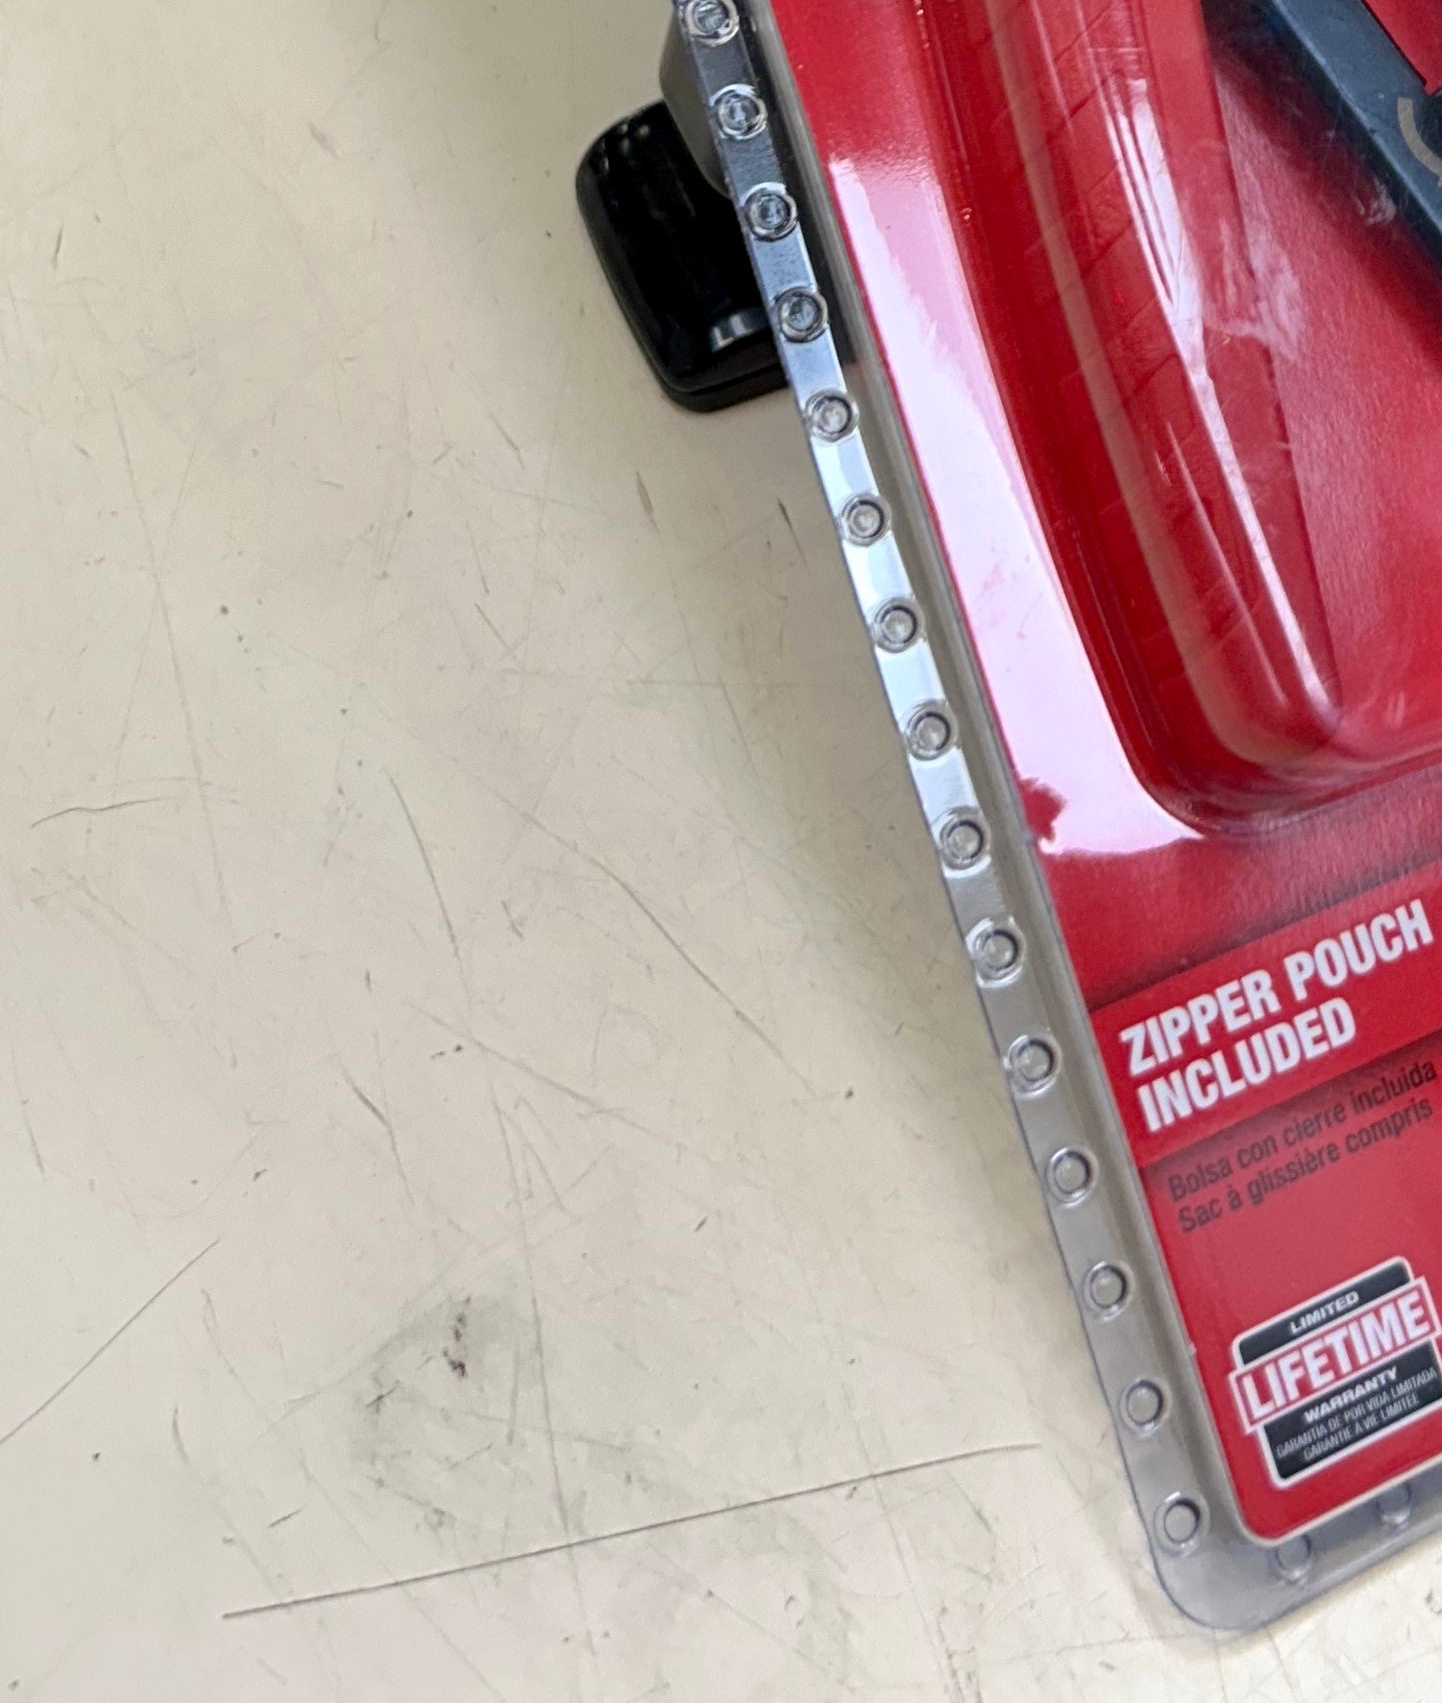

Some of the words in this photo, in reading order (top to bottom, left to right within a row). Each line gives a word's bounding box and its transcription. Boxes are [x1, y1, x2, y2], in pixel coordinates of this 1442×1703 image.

[1118, 968, 1282, 1077] ZIPPER
[1284, 899, 1435, 1001] POUCH
[1136, 997, 1357, 1133] INCLUDED
[1167, 1155, 1234, 1203] Bolsa
[1237, 1136, 1279, 1171] con
[1281, 1104, 1347, 1148] cierre
[1351, 1058, 1438, 1117] incluida
[1177, 1196, 1224, 1235] Sac
[1246, 1139, 1341, 1205] glissière
[1345, 1097, 1434, 1154] compris
[1241, 1289, 1431, 1420] LIFETIME
[1289, 1290, 1360, 1334] LIMITED
[1302, 1365, 1398, 1424] WARRANTY
